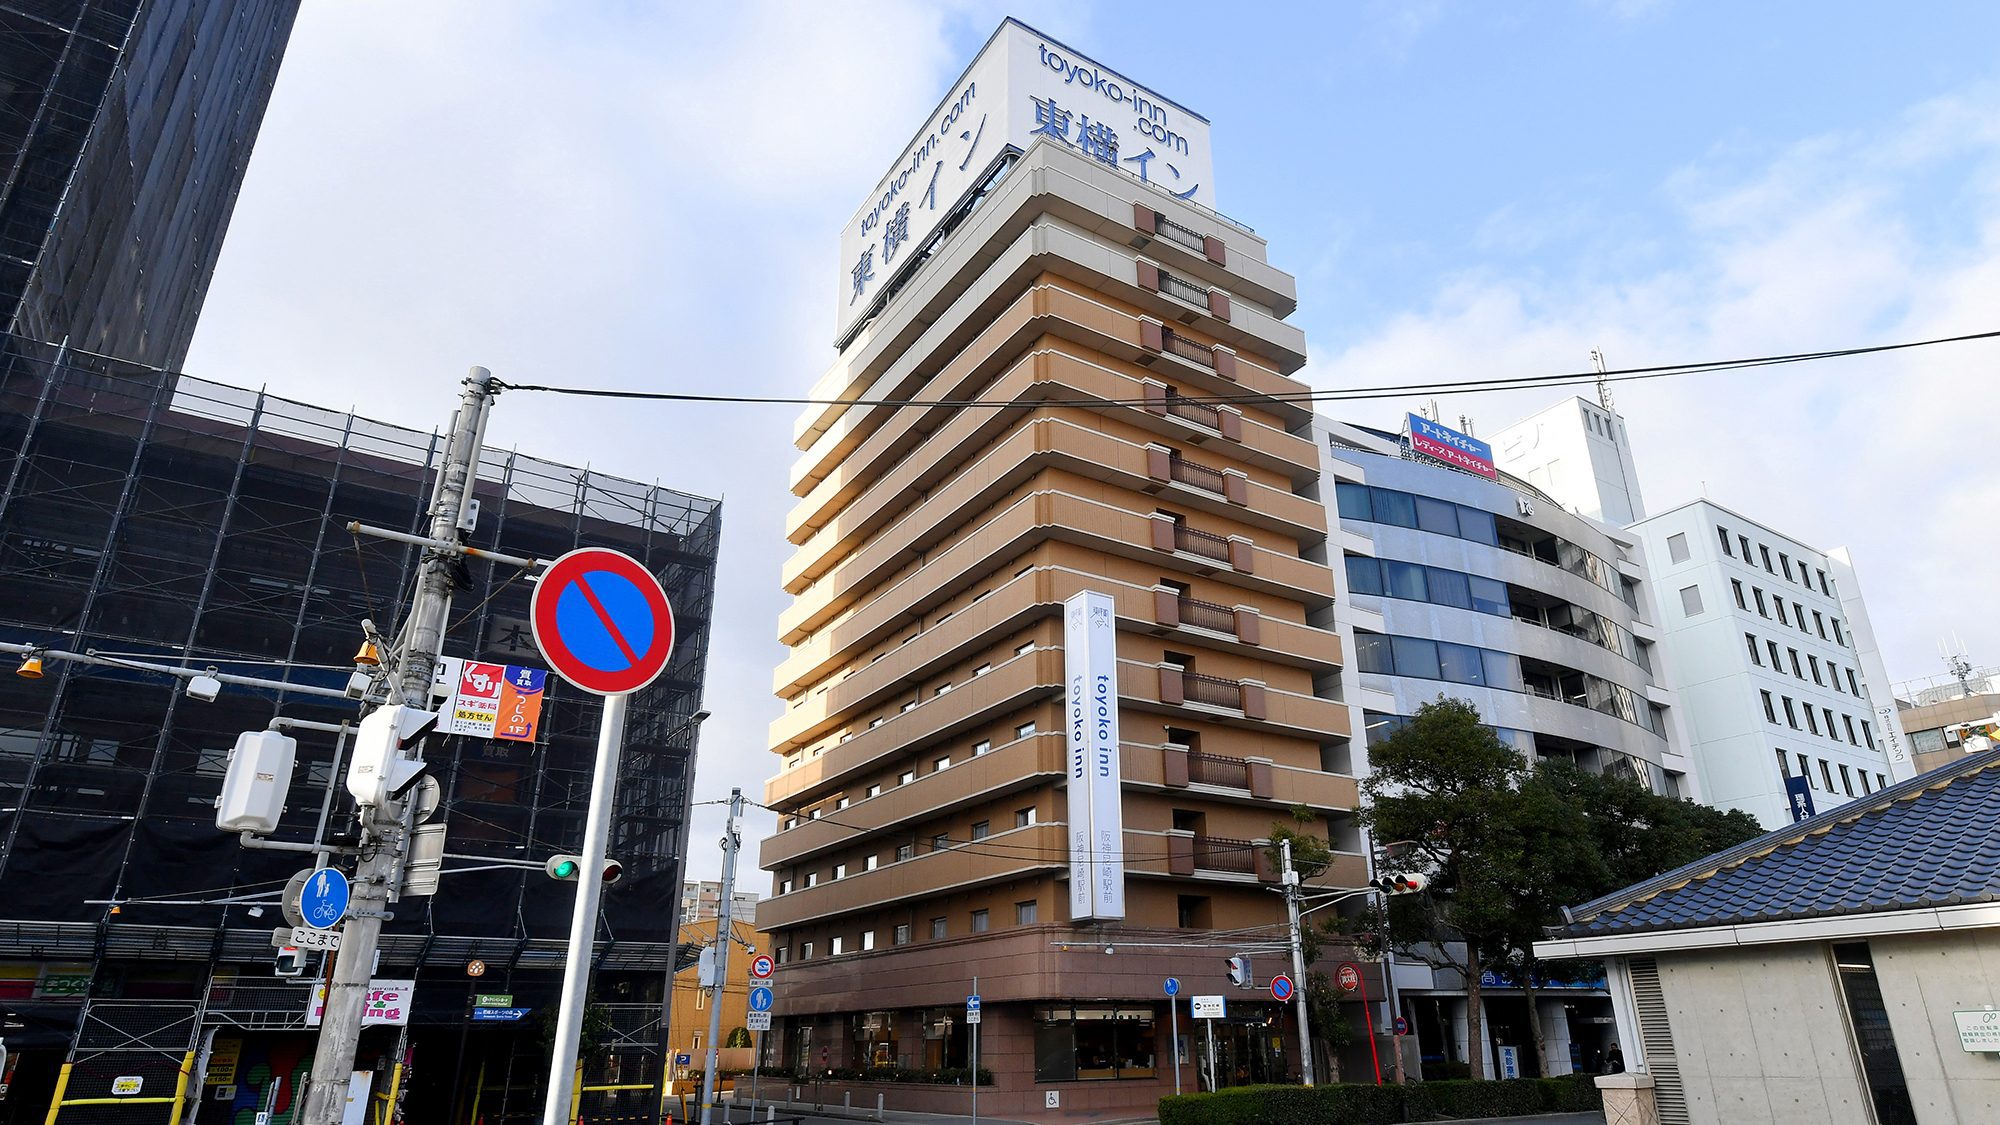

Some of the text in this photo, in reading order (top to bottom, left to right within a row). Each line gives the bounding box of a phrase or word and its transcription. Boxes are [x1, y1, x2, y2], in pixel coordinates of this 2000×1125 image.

[1039, 43, 1167, 126] toyoko-inn
[861, 82, 976, 238] toyoko-inn.com
[1030, 94, 1200, 200] 東横イン
[1133, 117, 1189, 156] .com
[850, 113, 987, 306] 東横イン
[1421, 422, 1482, 453] アートネイチャー
[457, 699, 497, 711] スギ薬局
[457, 710, 493, 722] 処方せん
[464, 663, 501, 698] くすり
[1072, 674, 1085, 779] toyoko inn
[1095, 674, 1112, 778] toyoko inn
[1101, 830, 1113, 904] 阪神尼崎駅前
[295, 930, 340, 948] ここまで
